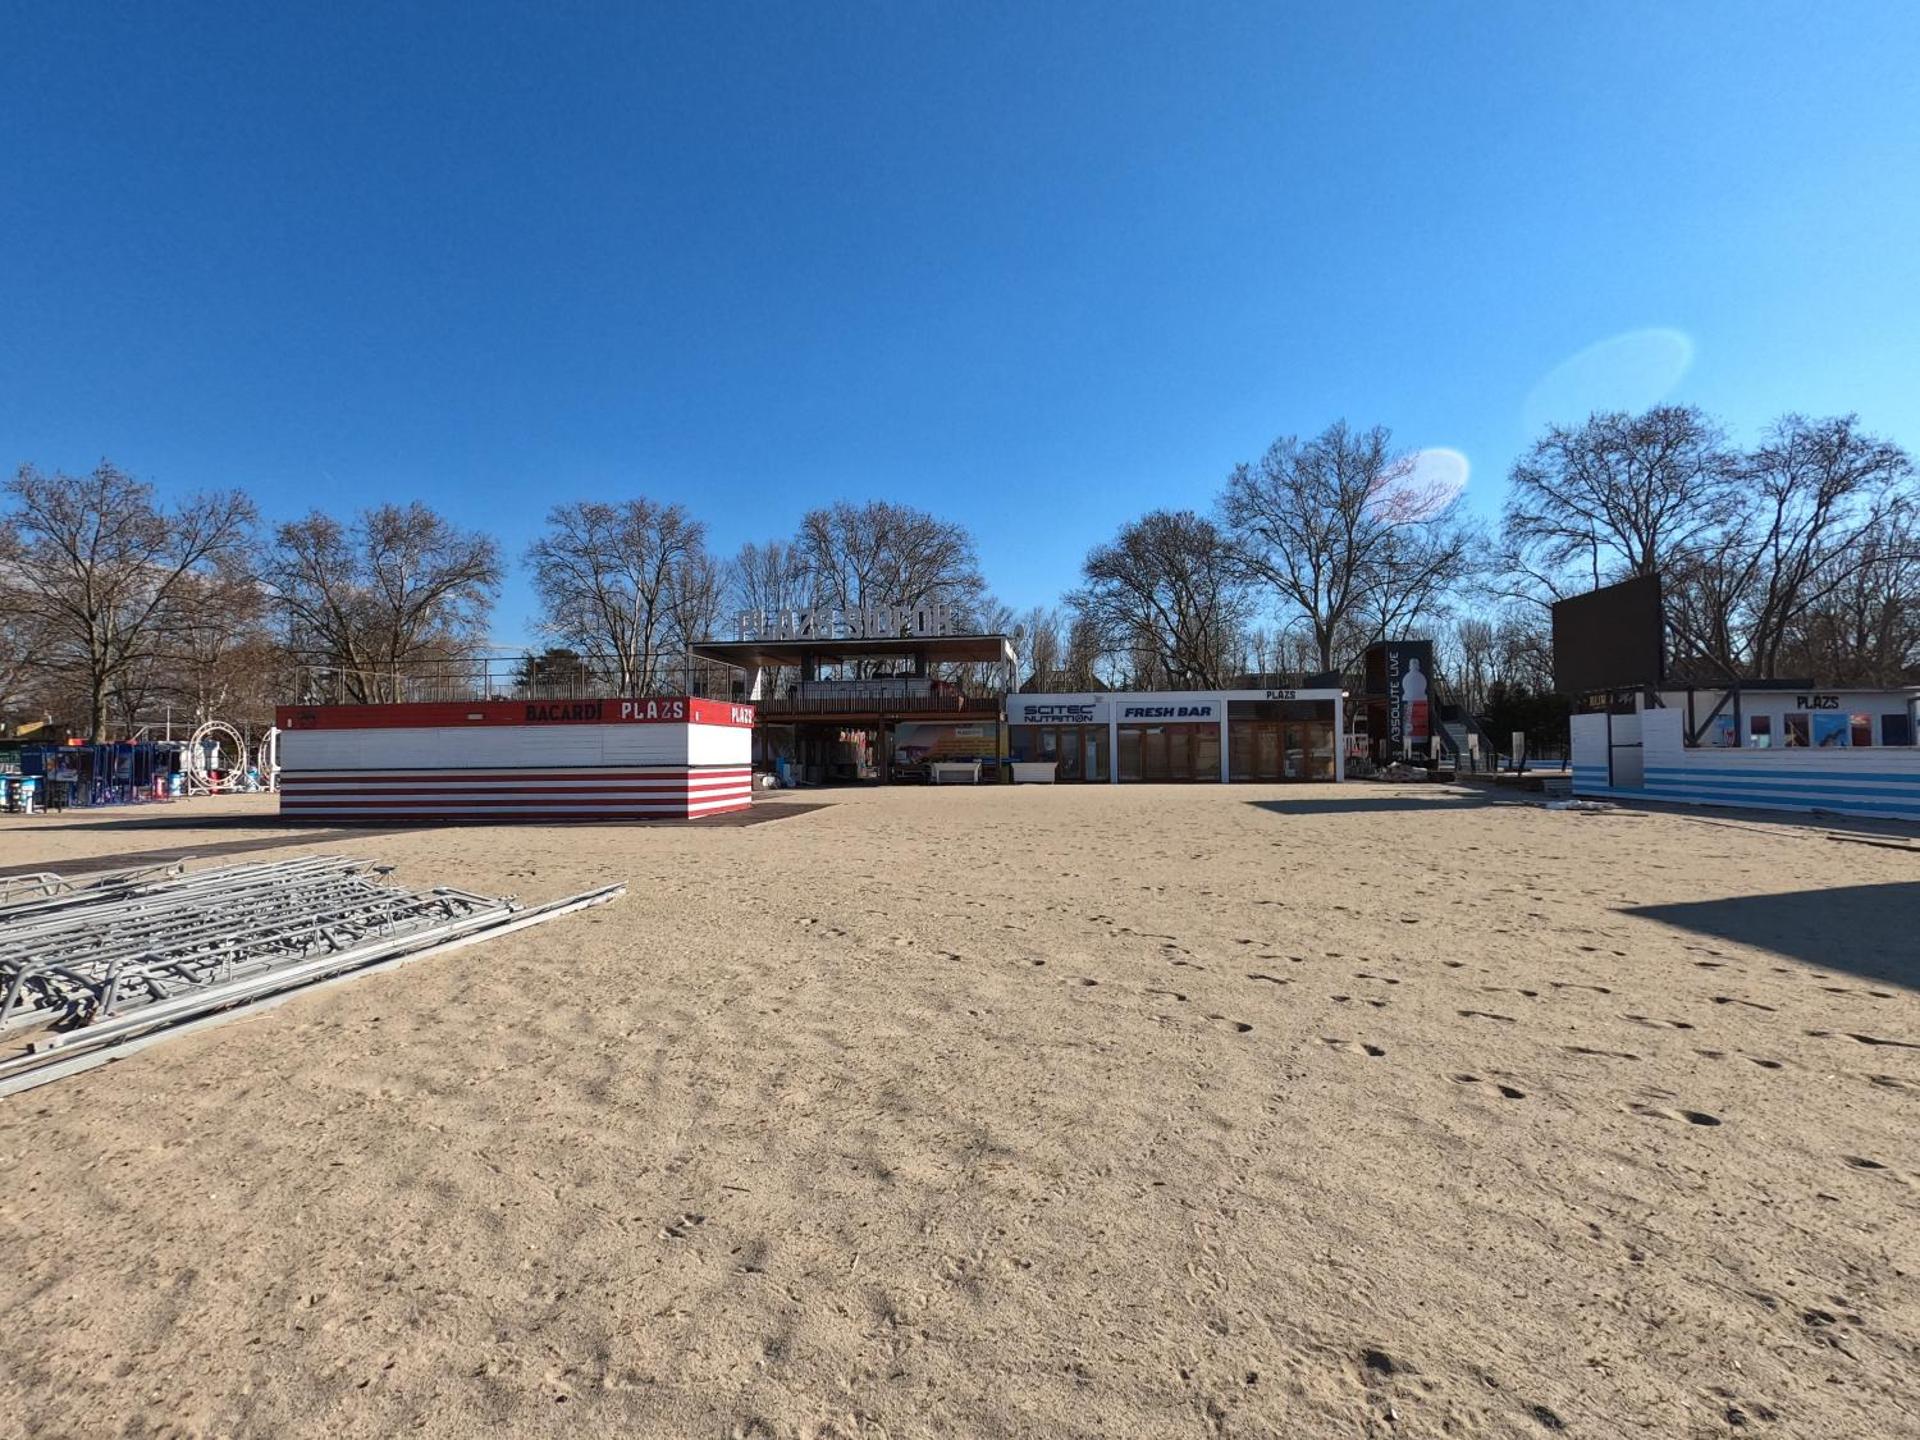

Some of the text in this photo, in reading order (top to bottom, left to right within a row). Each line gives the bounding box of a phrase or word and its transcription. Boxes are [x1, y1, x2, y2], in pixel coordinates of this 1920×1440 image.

[1390, 651, 1399, 679] LIVE
[1024, 704, 1096, 715] SCITEC
[1124, 706, 1212, 718] FRESH BAR
[1024, 715, 1093, 723] NUTRITION
